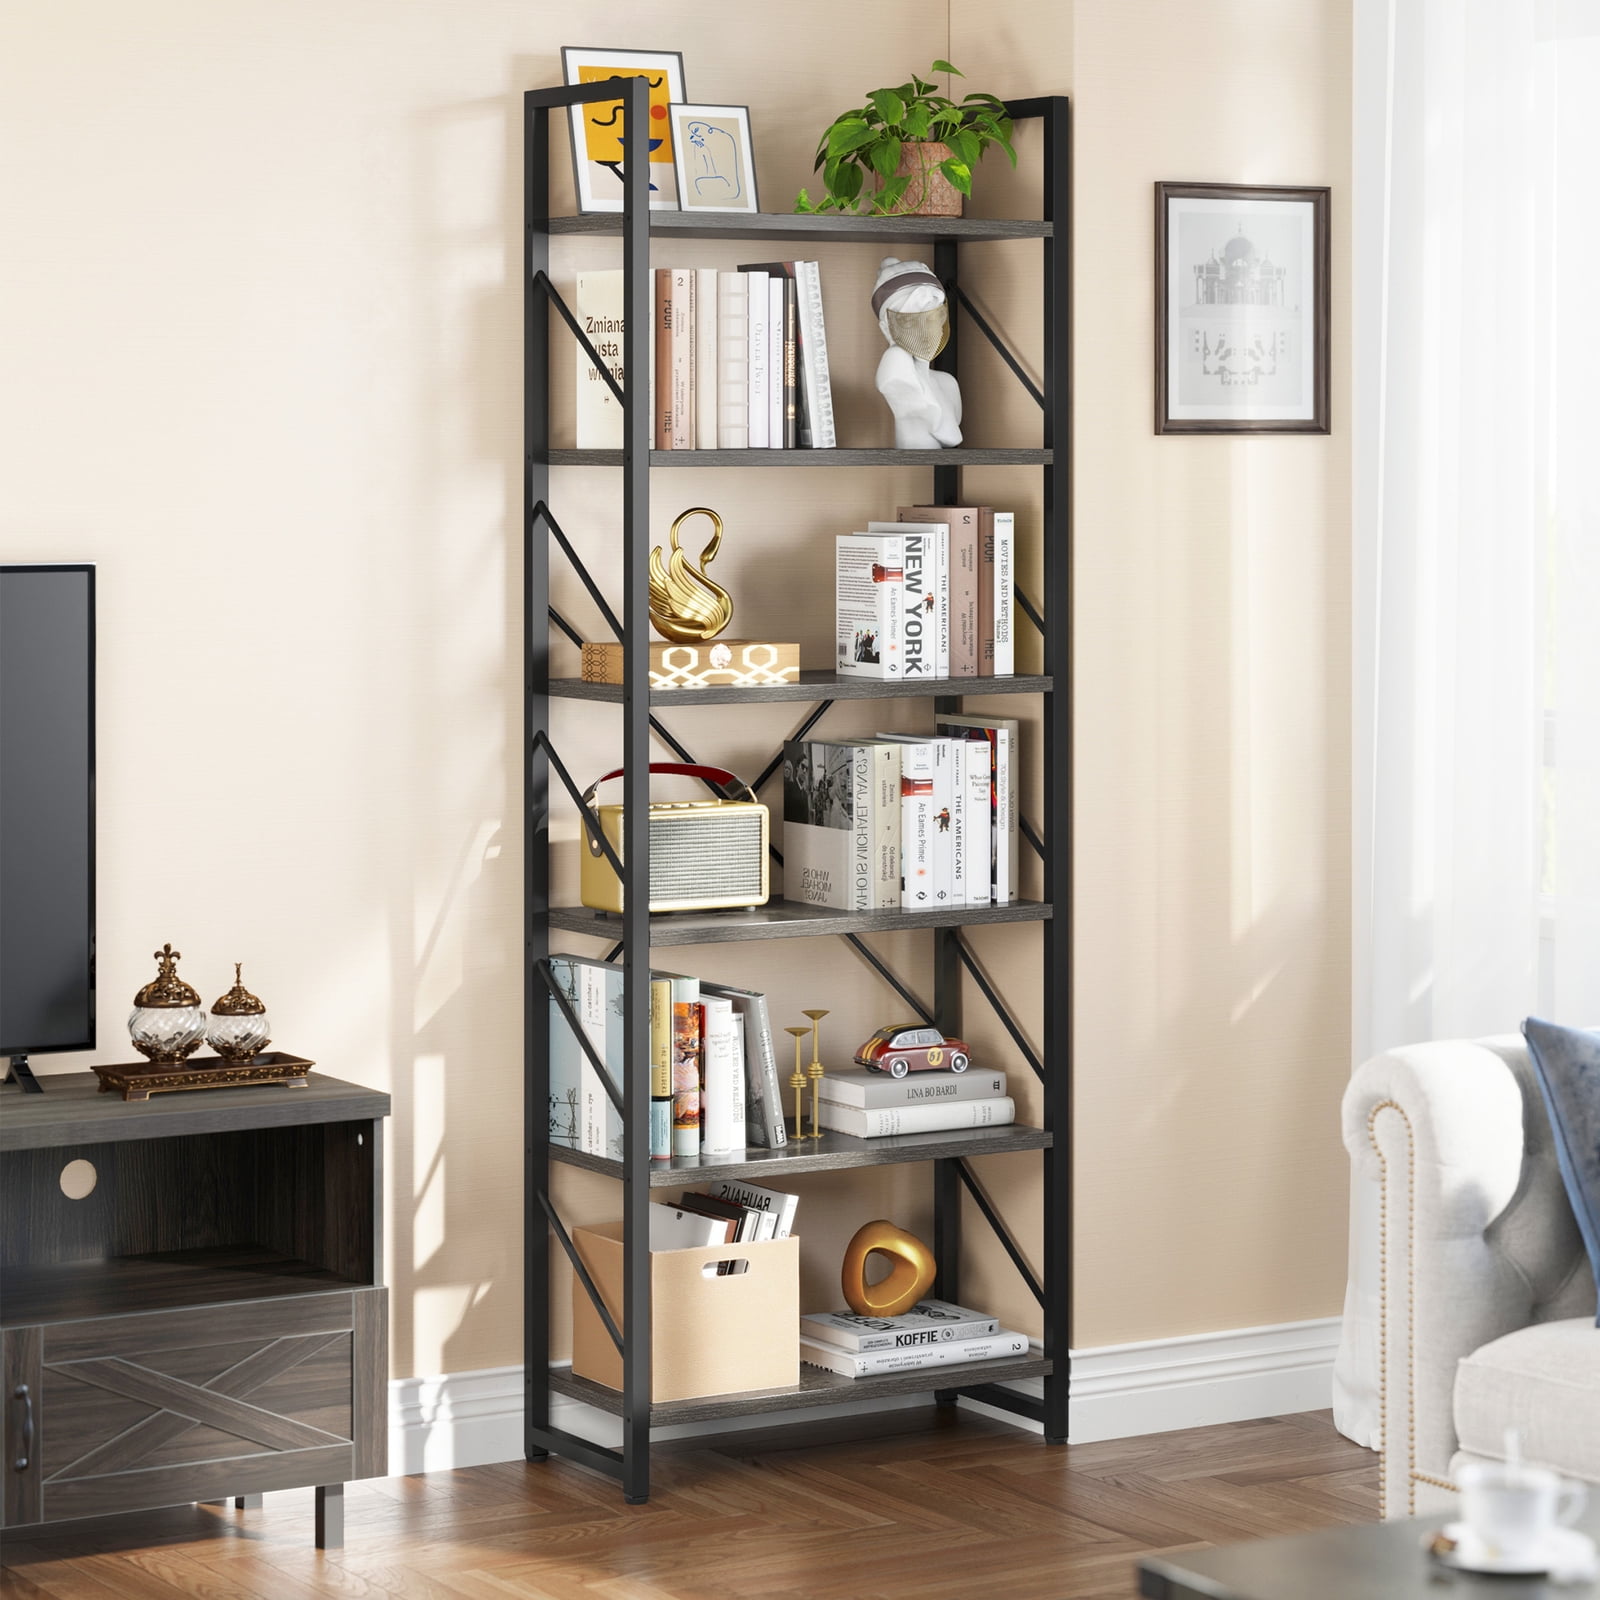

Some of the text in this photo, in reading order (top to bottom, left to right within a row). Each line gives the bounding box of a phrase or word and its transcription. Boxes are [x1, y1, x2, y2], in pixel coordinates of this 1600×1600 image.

[677, 277, 684, 287] 2
[890, 588, 897, 596] An
[905, 536, 922, 674] NEW YORK
[884, 752, 890, 760] 1
[919, 803, 926, 812] An
[907, 1085, 958, 1100] LINA BO BARDI
[896, 1330, 938, 1347] KOFFIE
